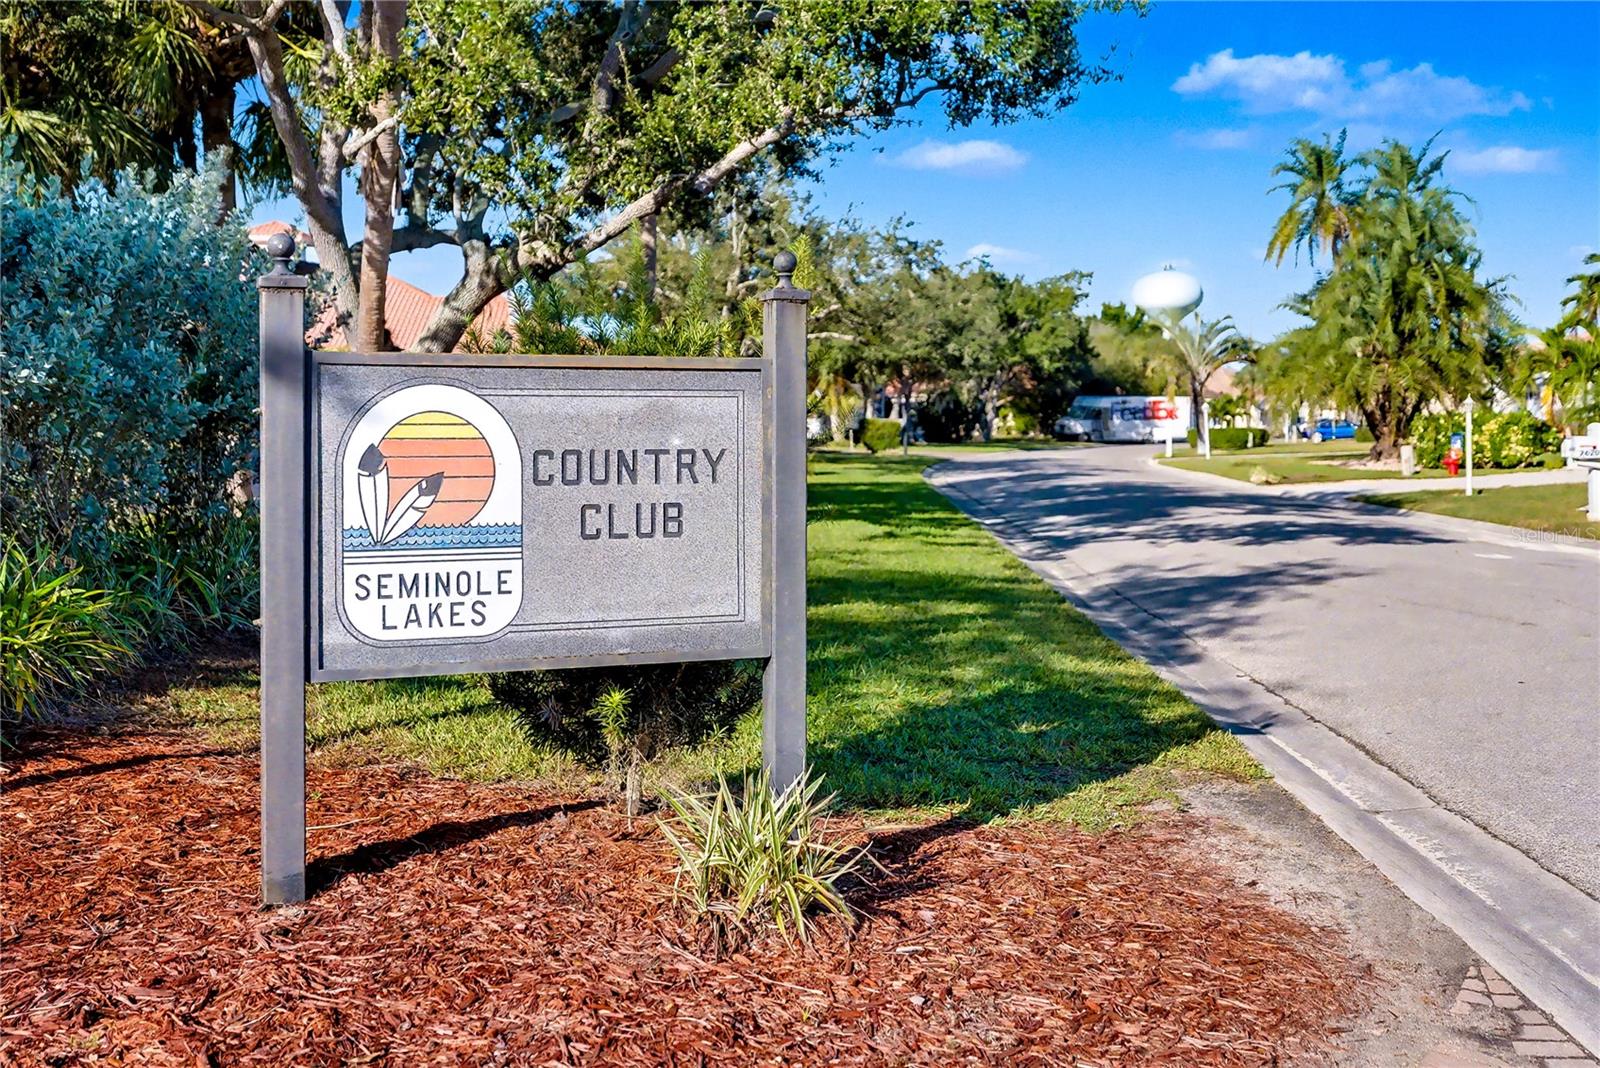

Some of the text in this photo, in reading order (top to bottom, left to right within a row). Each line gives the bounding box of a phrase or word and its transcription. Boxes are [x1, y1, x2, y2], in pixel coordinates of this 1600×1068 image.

[1111, 400, 1178, 421] FedEx
[532, 448, 727, 486] COUNTRY
[580, 502, 684, 540] CLUB
[354, 570, 513, 601] SEMINOLE
[381, 600, 487, 630] LAKES
